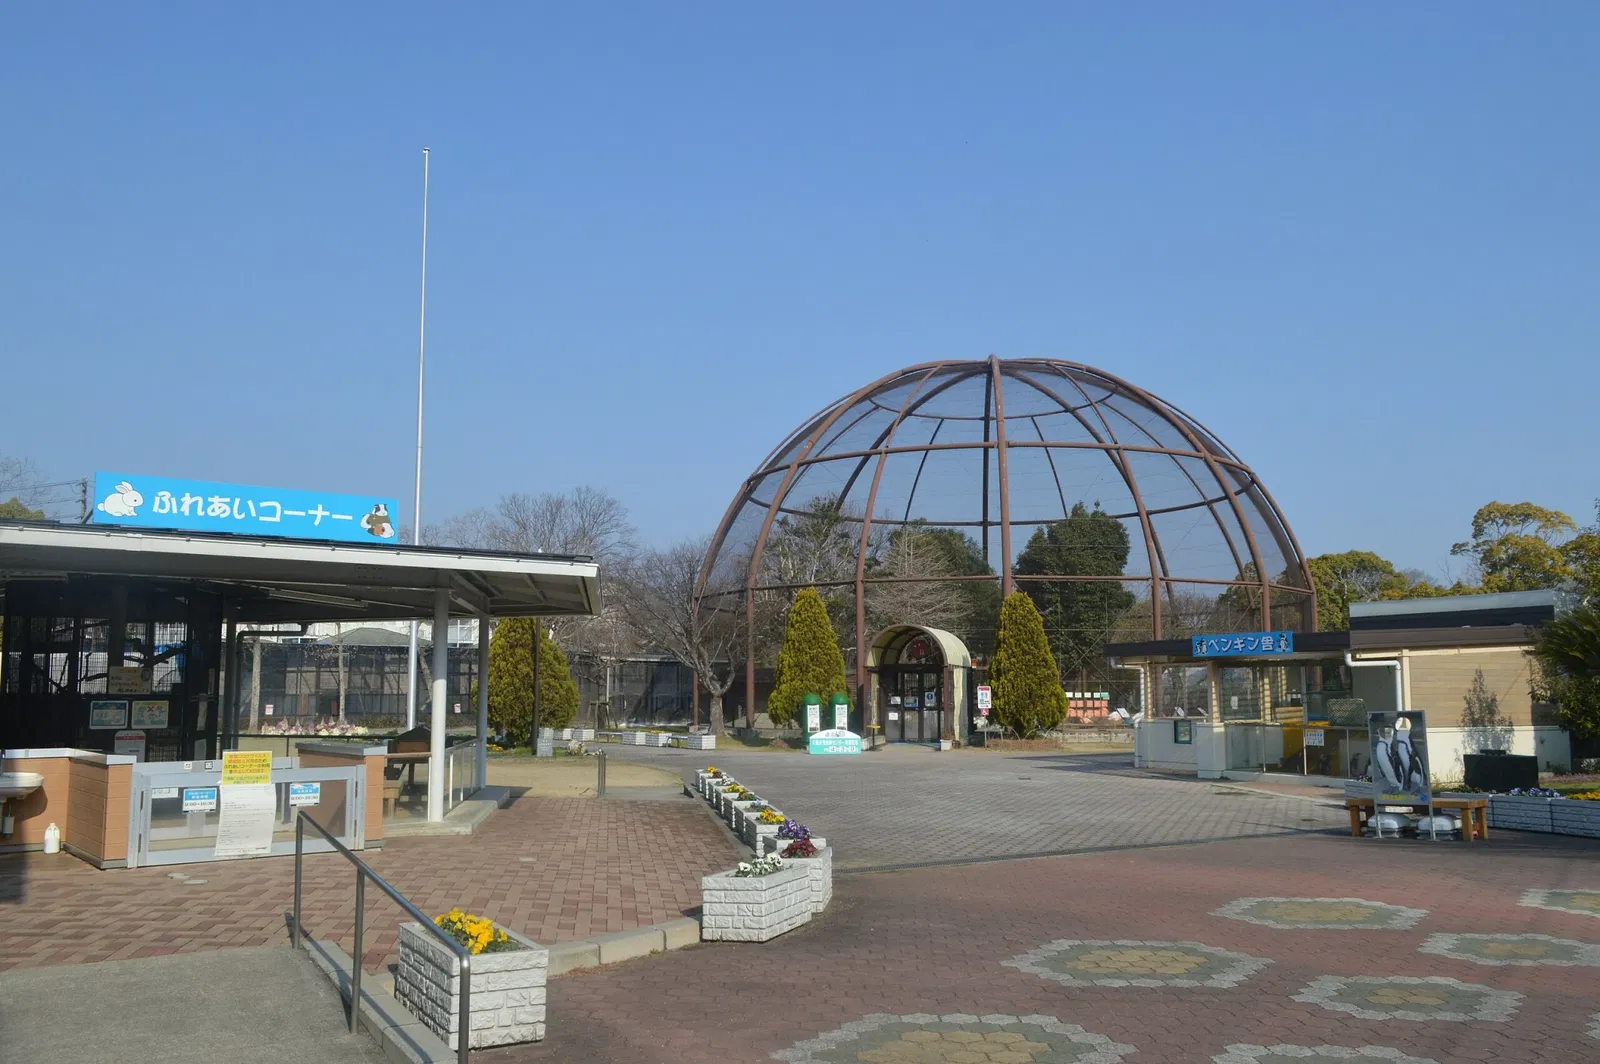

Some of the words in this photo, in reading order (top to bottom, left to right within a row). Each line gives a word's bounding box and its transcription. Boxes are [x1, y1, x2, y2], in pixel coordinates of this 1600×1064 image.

[152, 490, 353, 526] ふれあいコーナー
[1208, 635, 1274, 653] ペンギン舎
